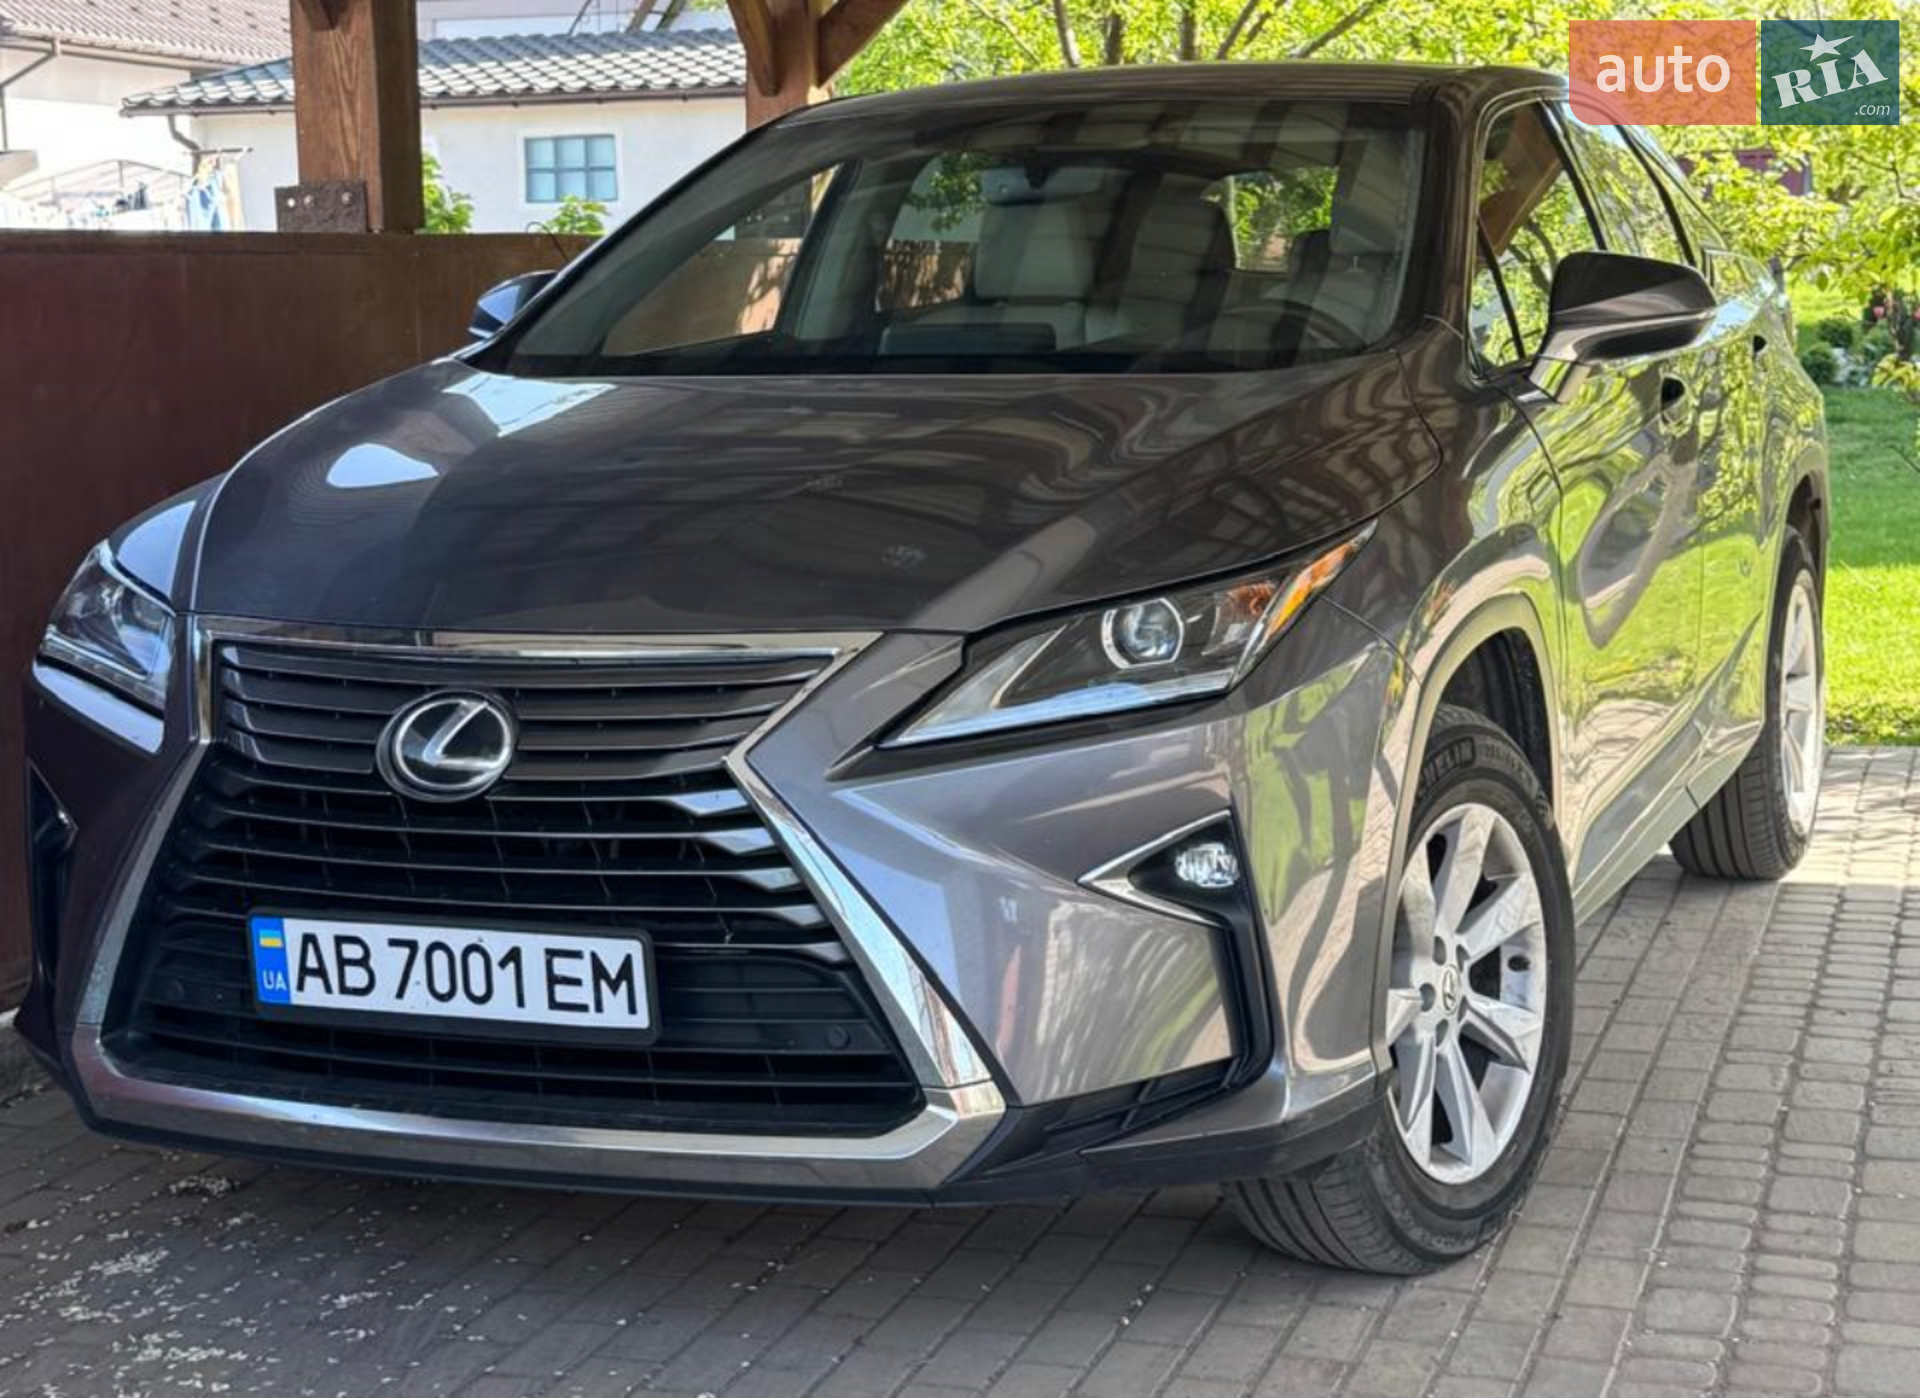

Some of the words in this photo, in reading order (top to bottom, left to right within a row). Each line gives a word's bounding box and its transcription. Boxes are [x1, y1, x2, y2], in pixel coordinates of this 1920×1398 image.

[262, 970, 287, 992] UA
[296, 933, 376, 997] AB
[388, 939, 525, 1008] 7001
[545, 948, 638, 1015] EM
